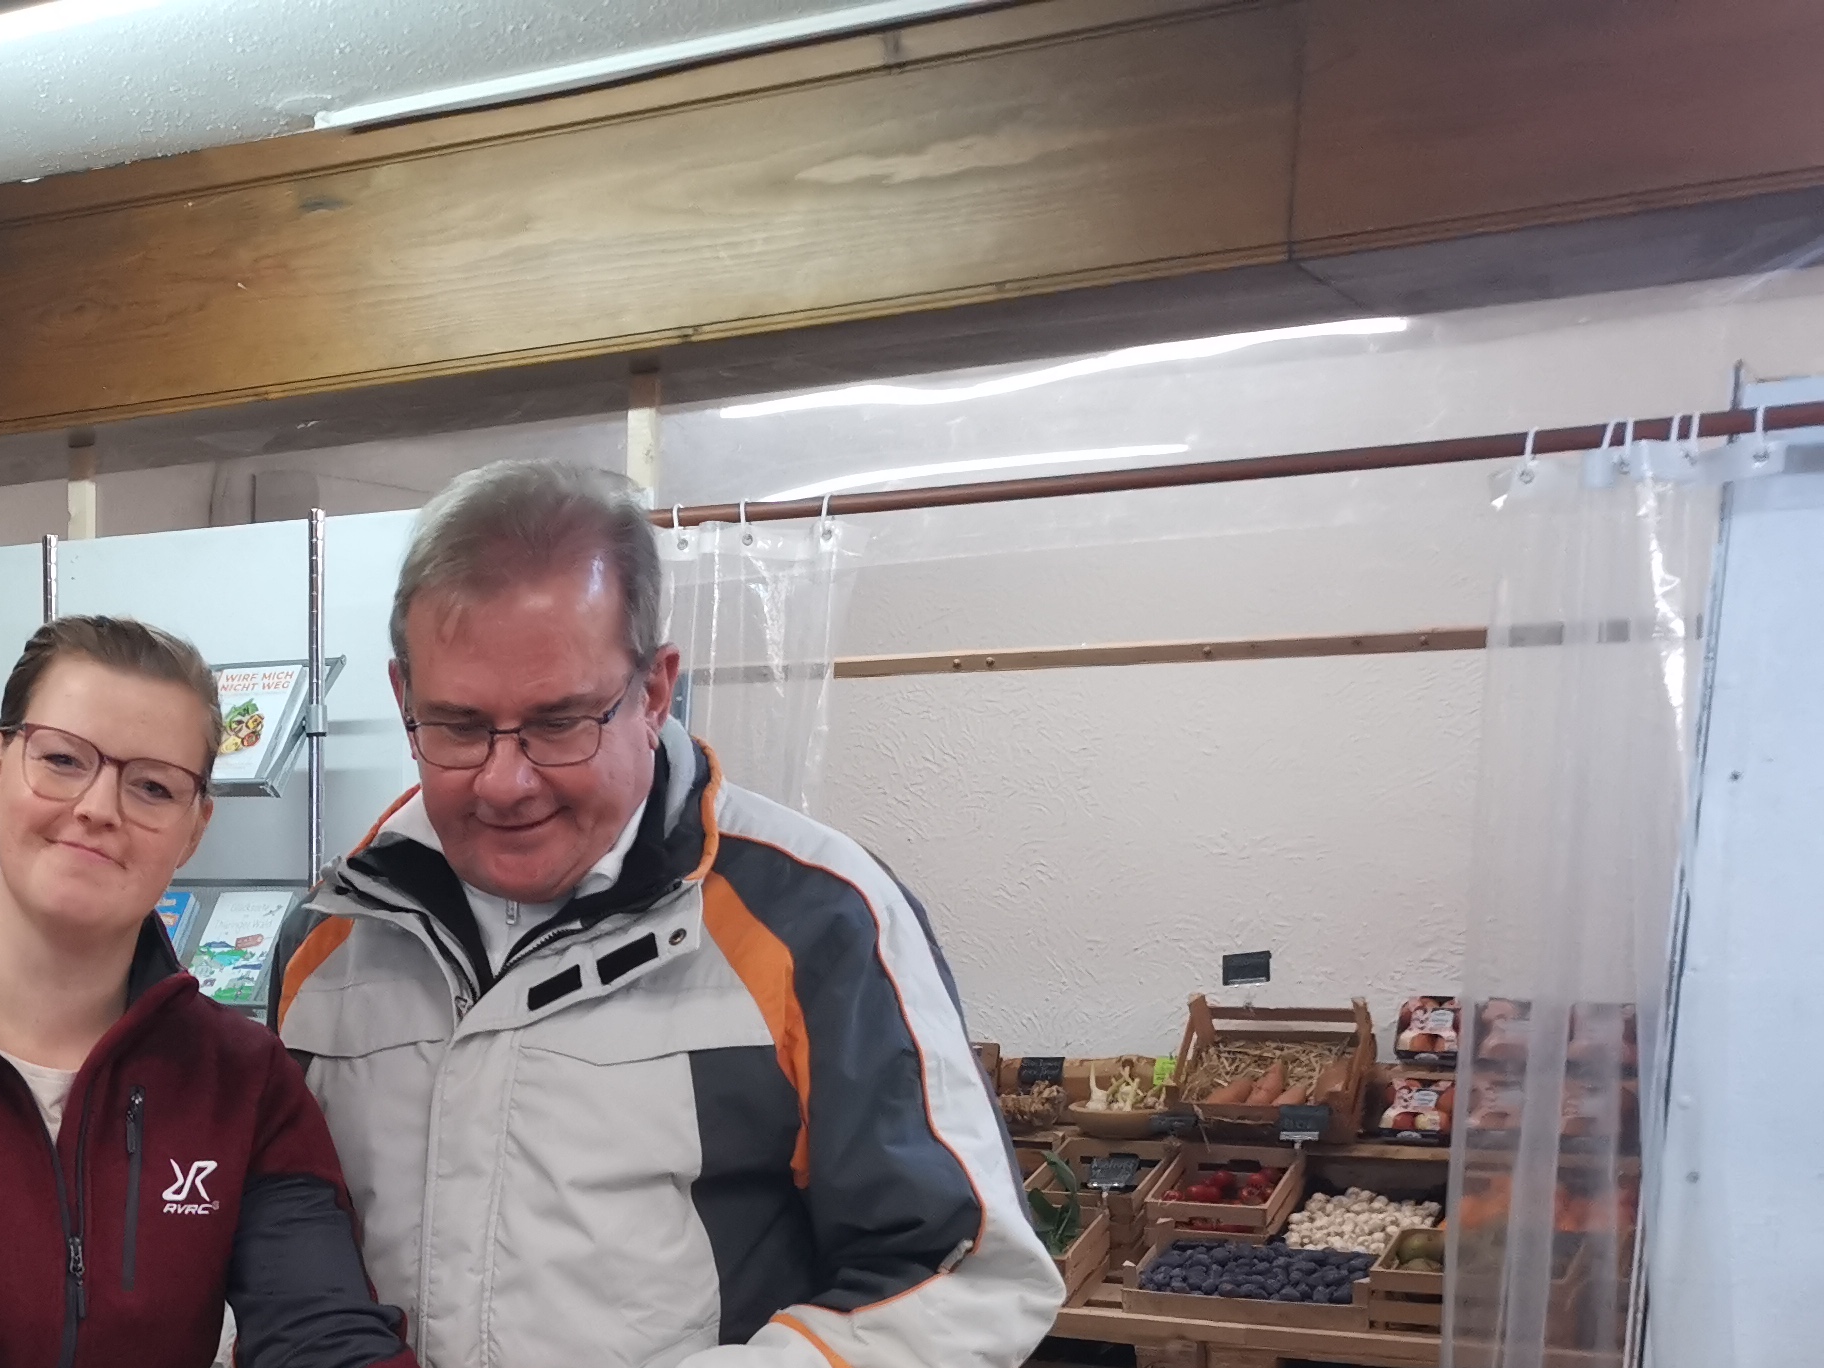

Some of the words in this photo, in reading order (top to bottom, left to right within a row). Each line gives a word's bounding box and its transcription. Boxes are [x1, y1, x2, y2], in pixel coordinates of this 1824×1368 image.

[226, 673, 258, 683] WIRF
[262, 671, 294, 682] MICH
[220, 682, 258, 692] NICHT
[262, 681, 291, 690] WEG
